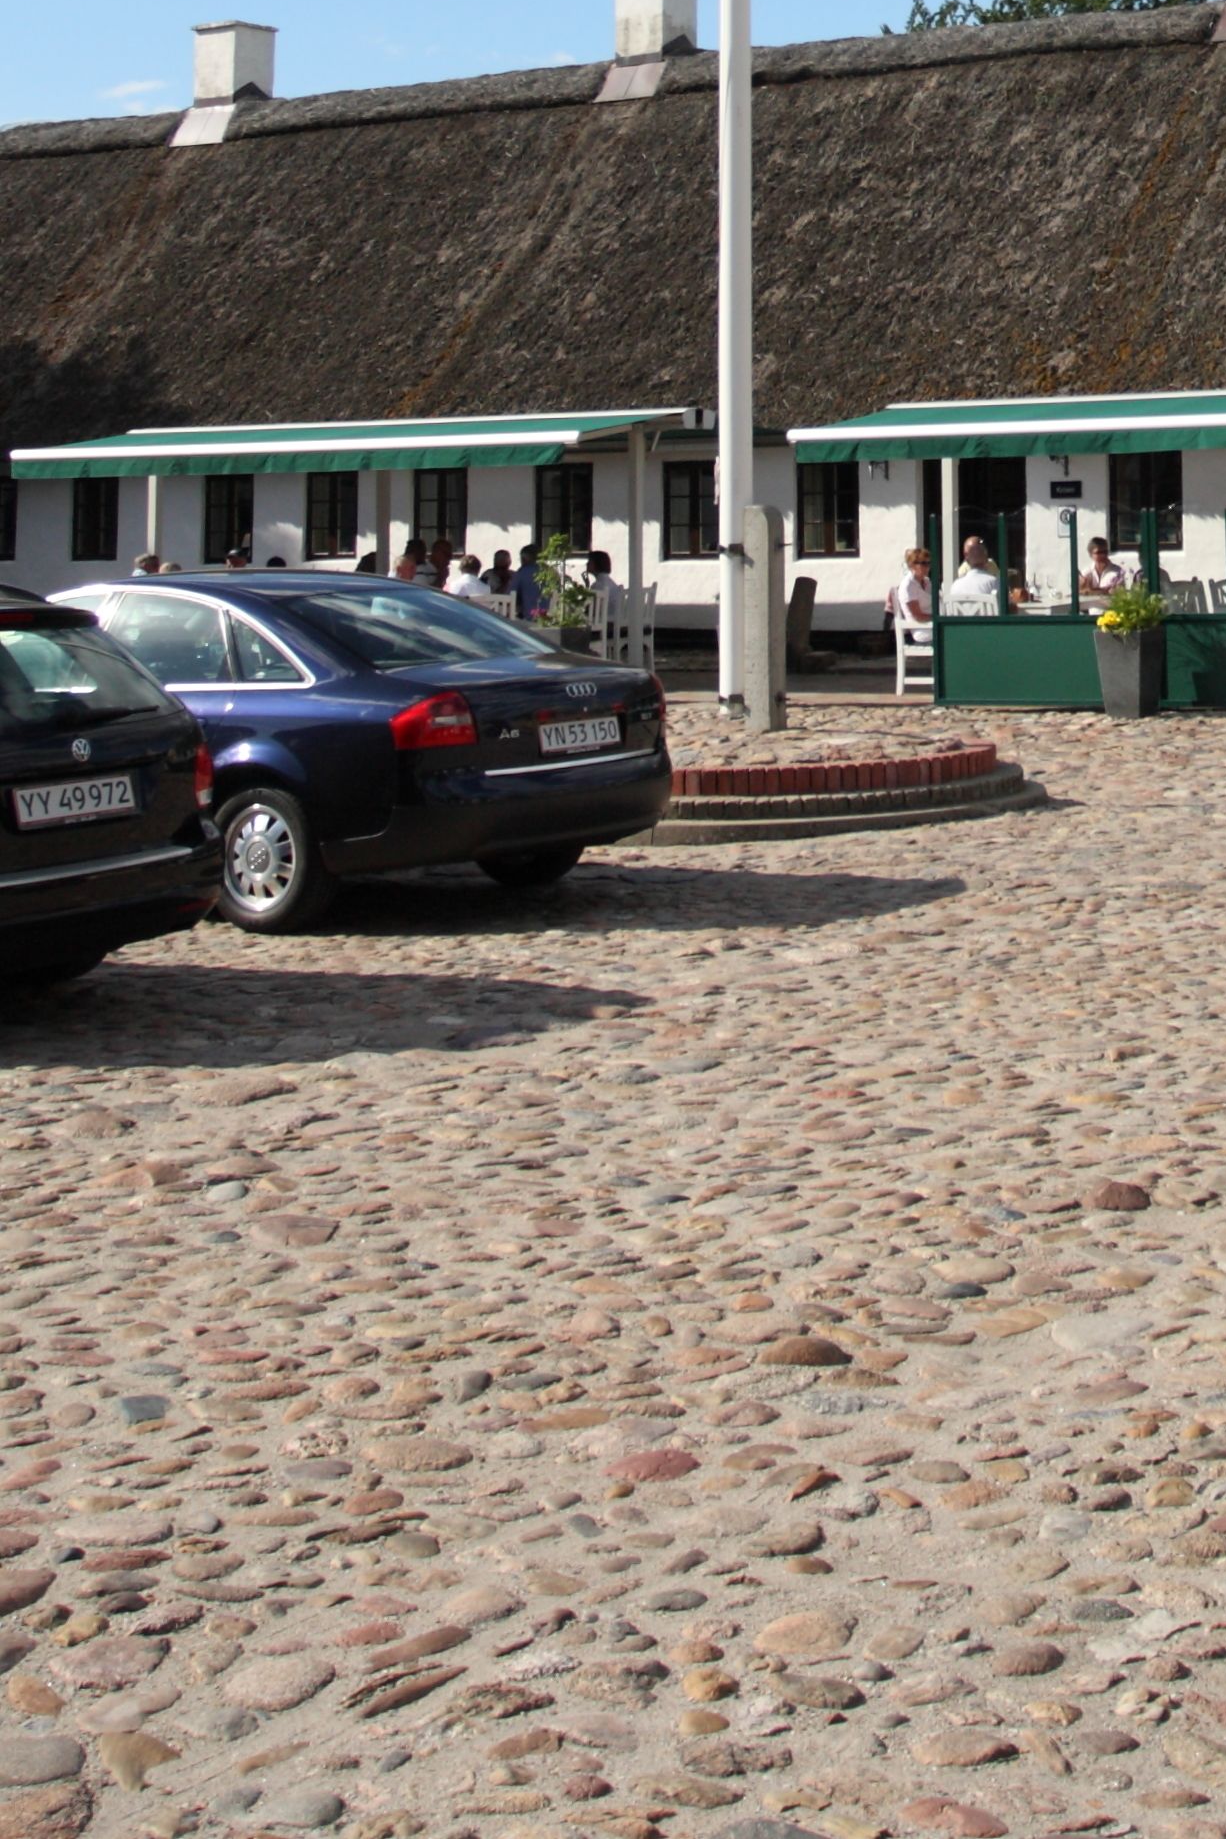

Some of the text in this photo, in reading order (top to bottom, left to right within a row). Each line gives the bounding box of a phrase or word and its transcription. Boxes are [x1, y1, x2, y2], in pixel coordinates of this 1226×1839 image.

[499, 728, 520, 739] A6
[543, 720, 617, 746] YN 53 150
[20, 790, 51, 817] YY
